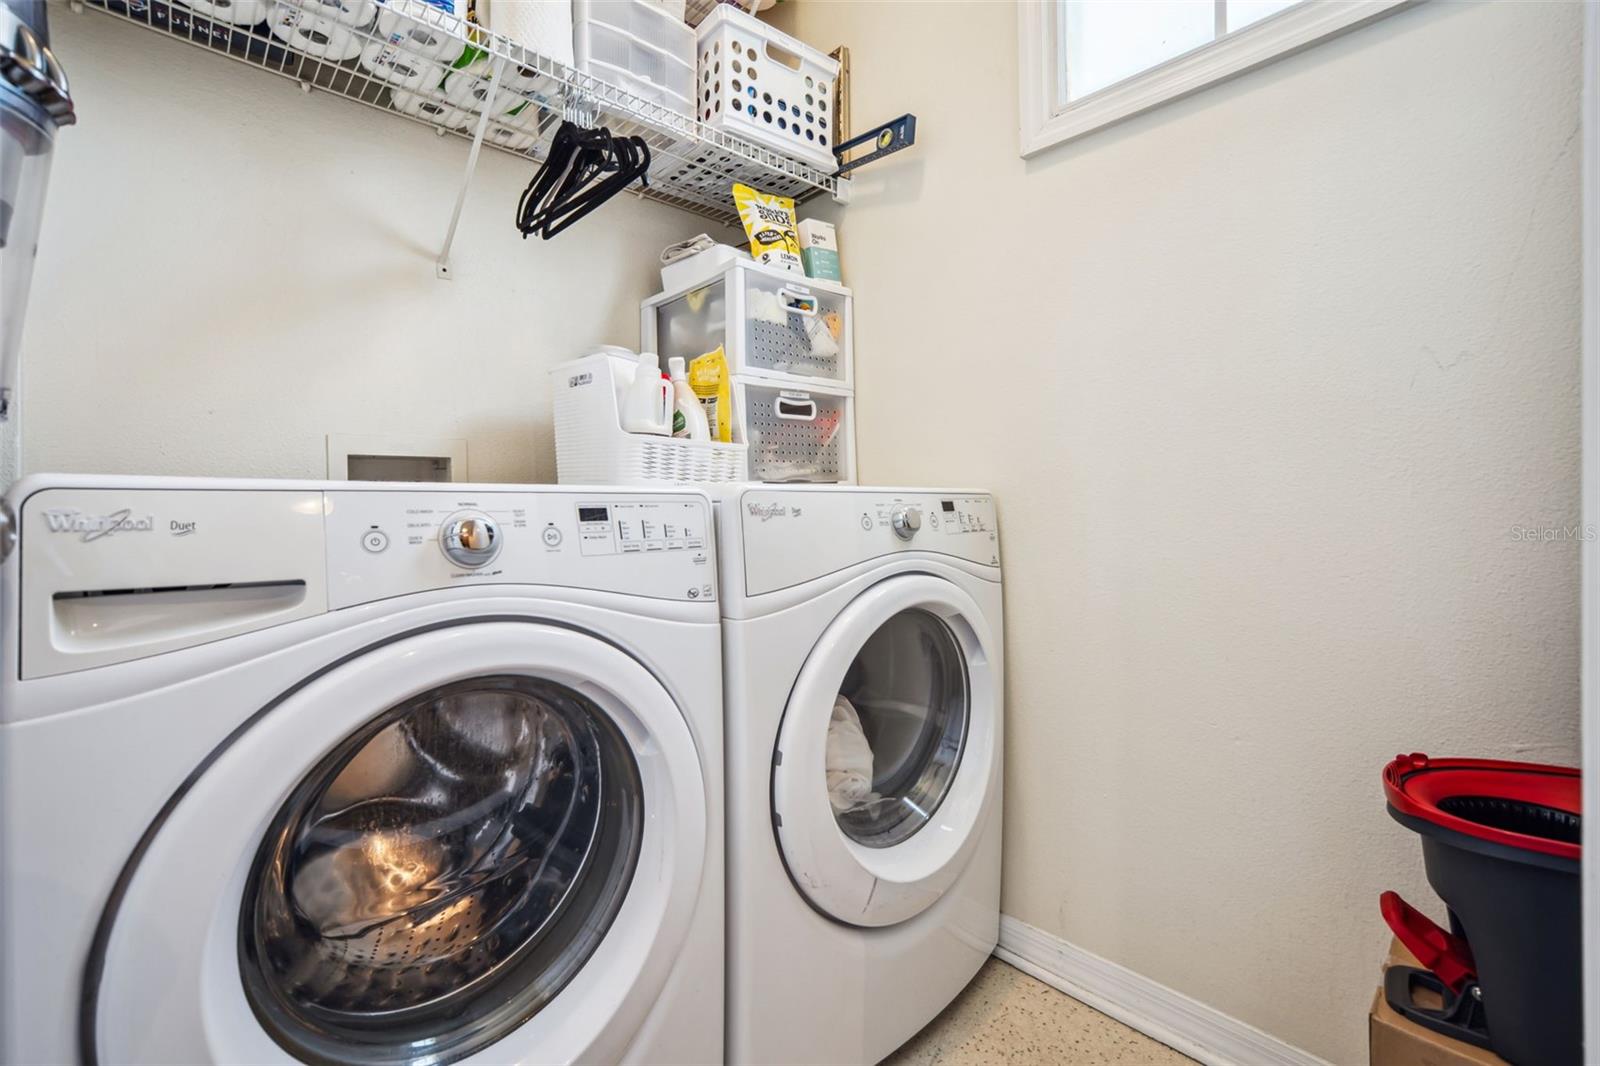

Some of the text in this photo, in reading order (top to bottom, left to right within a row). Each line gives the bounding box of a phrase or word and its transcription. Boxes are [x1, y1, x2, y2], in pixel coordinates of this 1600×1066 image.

[780, 253, 799, 263] LEMON
[41, 508, 197, 543] Whirlpool Duet
